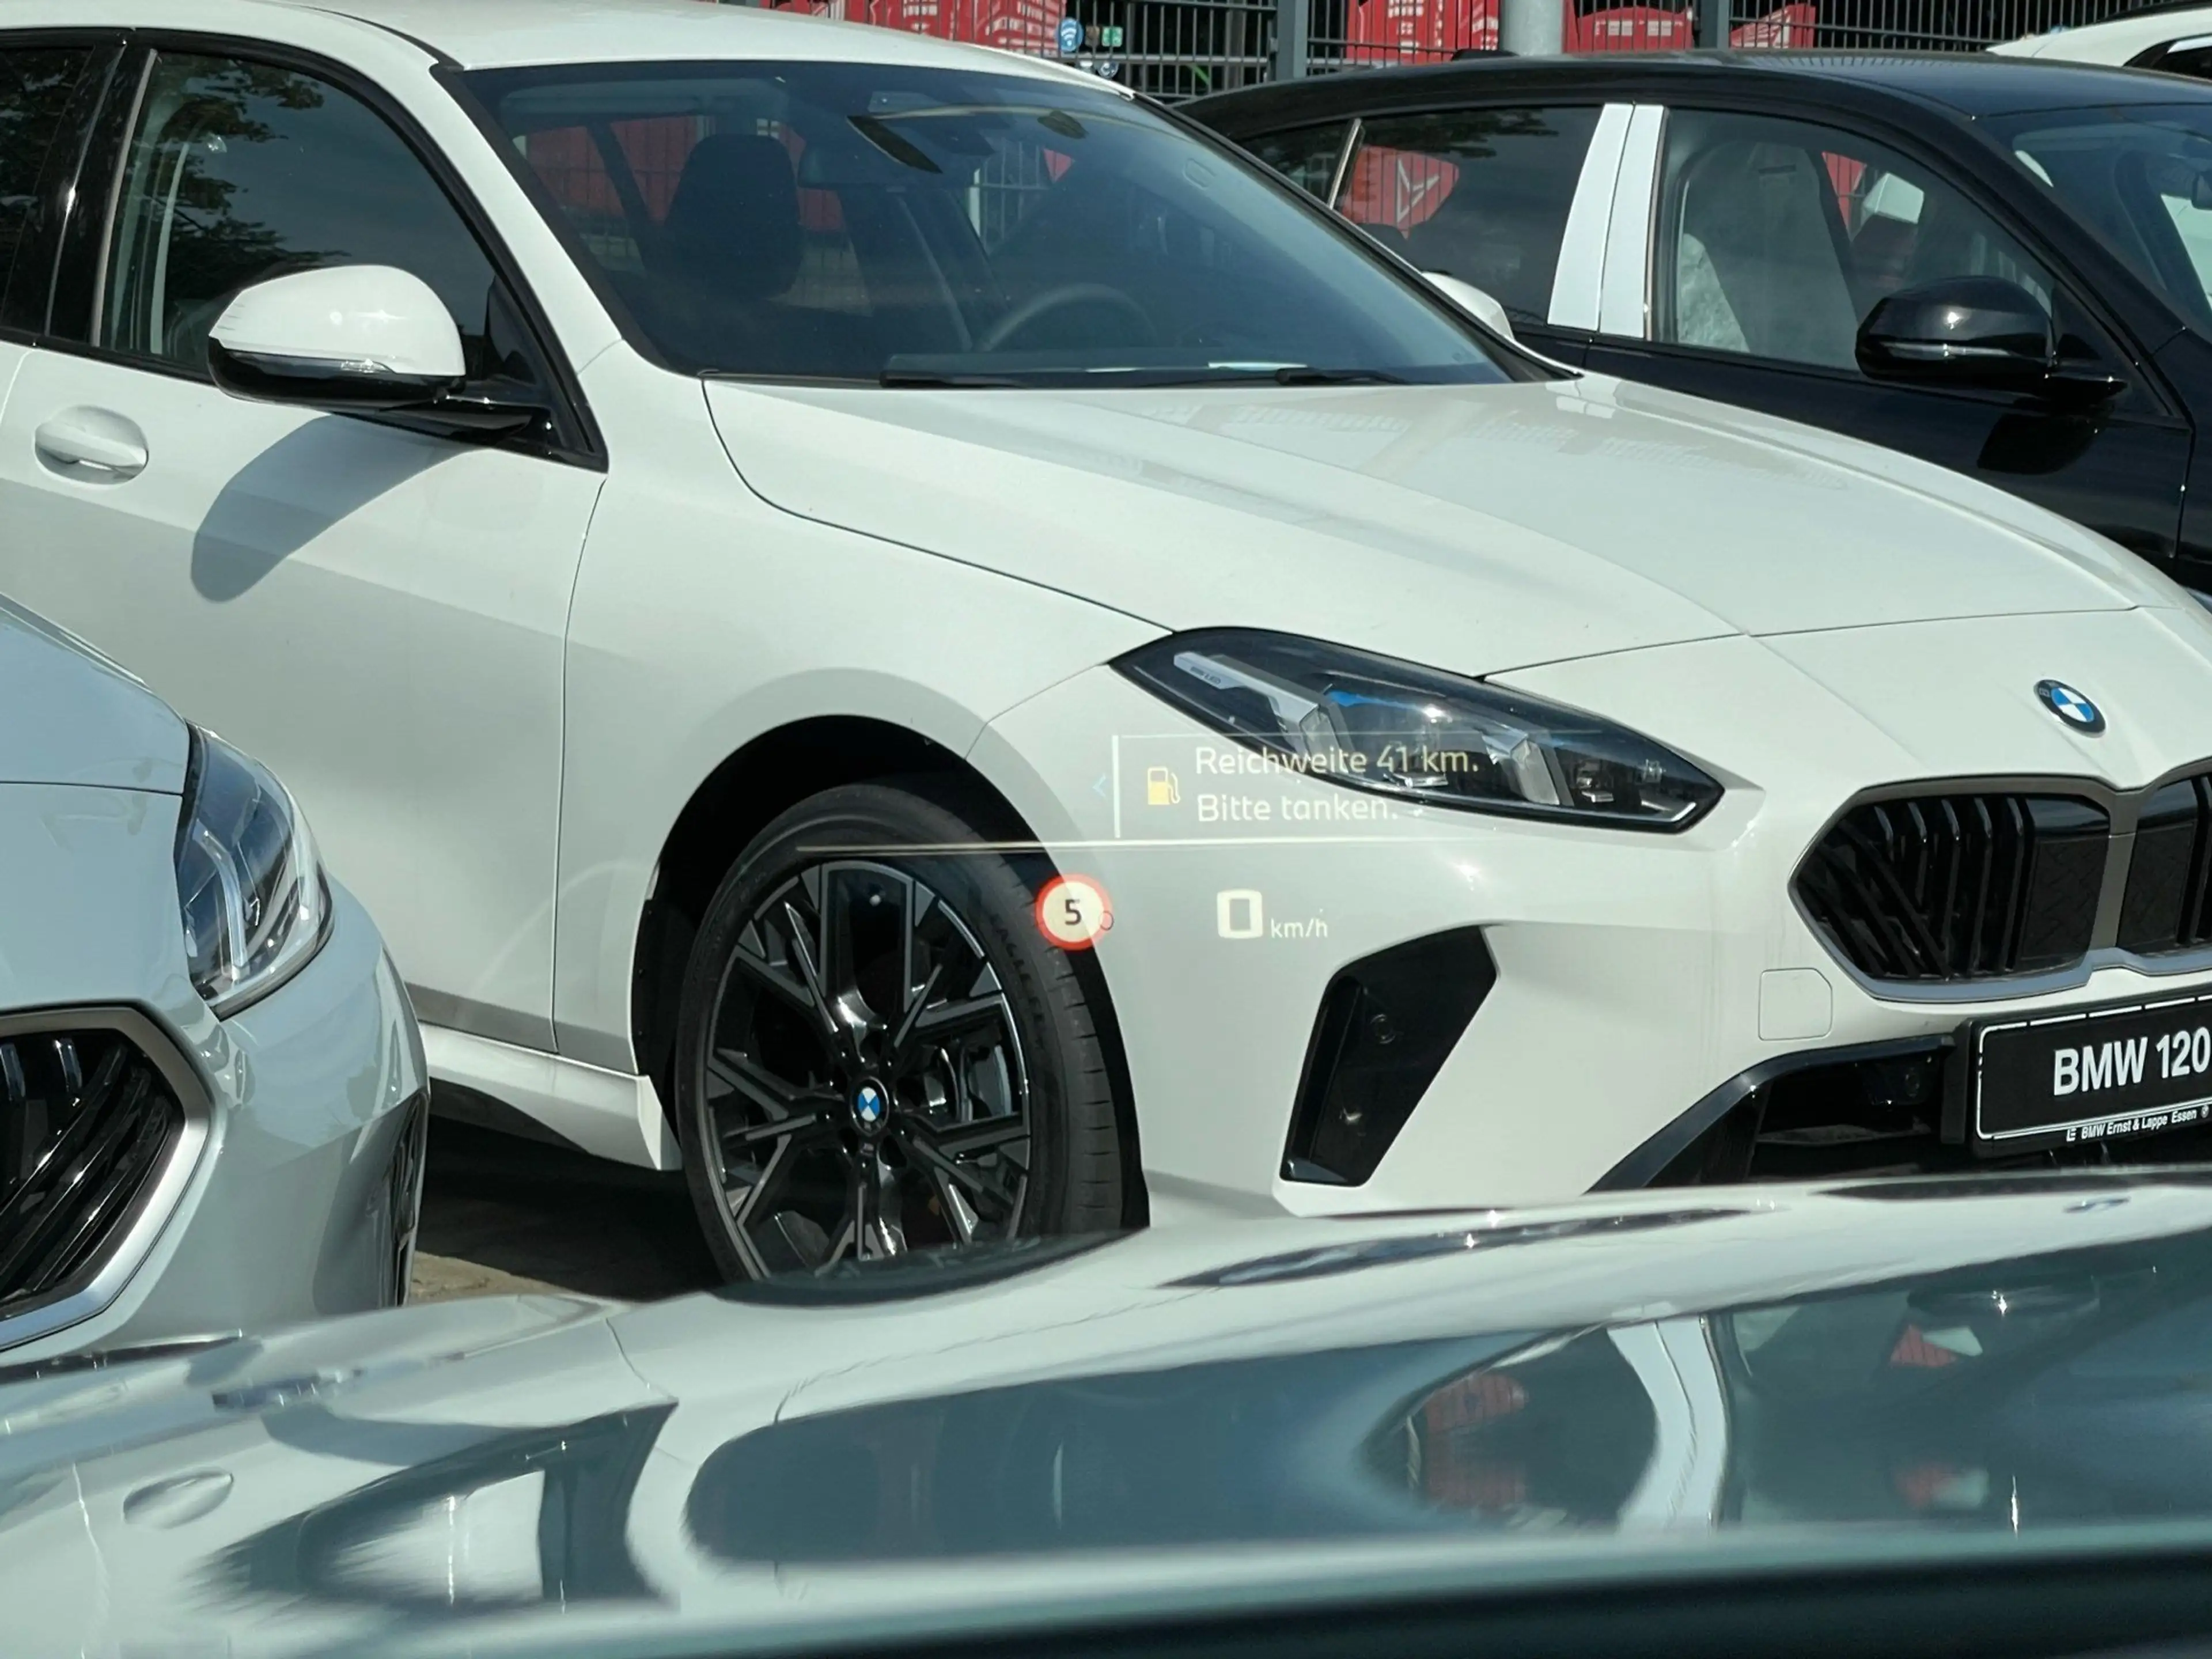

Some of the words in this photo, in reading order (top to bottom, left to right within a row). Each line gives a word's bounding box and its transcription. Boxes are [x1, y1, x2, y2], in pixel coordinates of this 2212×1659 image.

[1195, 747, 1367, 774] Reichweite
[1376, 745, 1408, 772] 41
[1423, 744, 1479, 772] km.
[1197, 793, 1271, 822] Bitte
[1281, 792, 1398, 821] tanken.
[1064, 898, 1082, 926] 5
[1217, 888, 1264, 939] 0
[1270, 917, 1328, 939] km/h
[2054, 1037, 2148, 1096] BMW
[2156, 1027, 2211, 1079] 120
[2081, 1123, 2106, 1140] BMW
[2107, 1119, 2131, 1135] Ernst
[2133, 1118, 2139, 1131] &
[2142, 1115, 2168, 1131] Lappe
[2171, 1109, 2197, 1124] Essen
